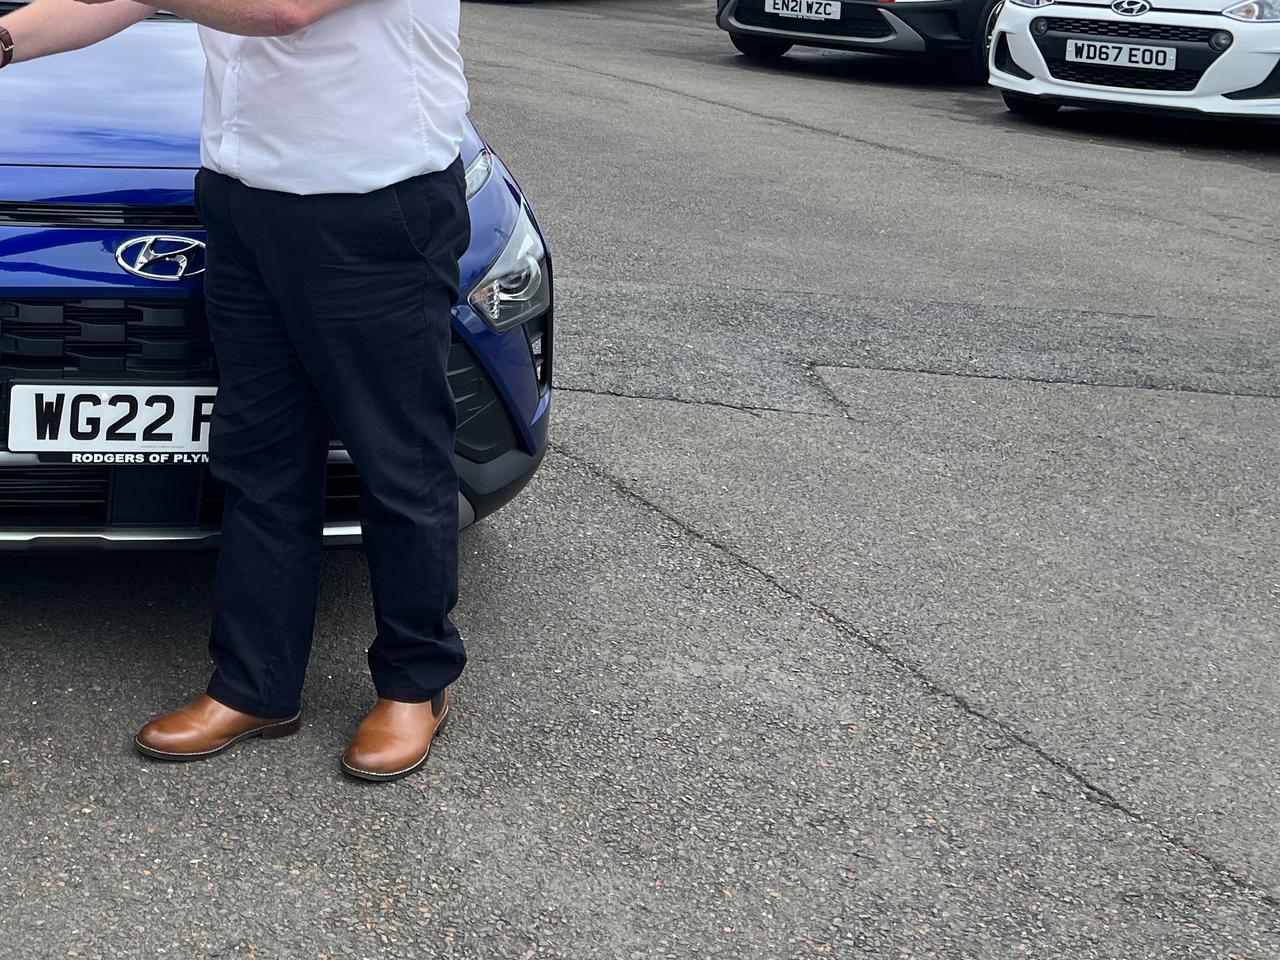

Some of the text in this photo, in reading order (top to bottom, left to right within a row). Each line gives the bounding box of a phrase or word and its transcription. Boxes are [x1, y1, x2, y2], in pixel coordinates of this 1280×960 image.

[806, 0, 832, 16] WZC
[1074, 42, 1167, 66] WD67 EOO
[34, 393, 175, 442] WG22
[71, 453, 145, 463] RODGERS
[149, 453, 169, 463] OF
